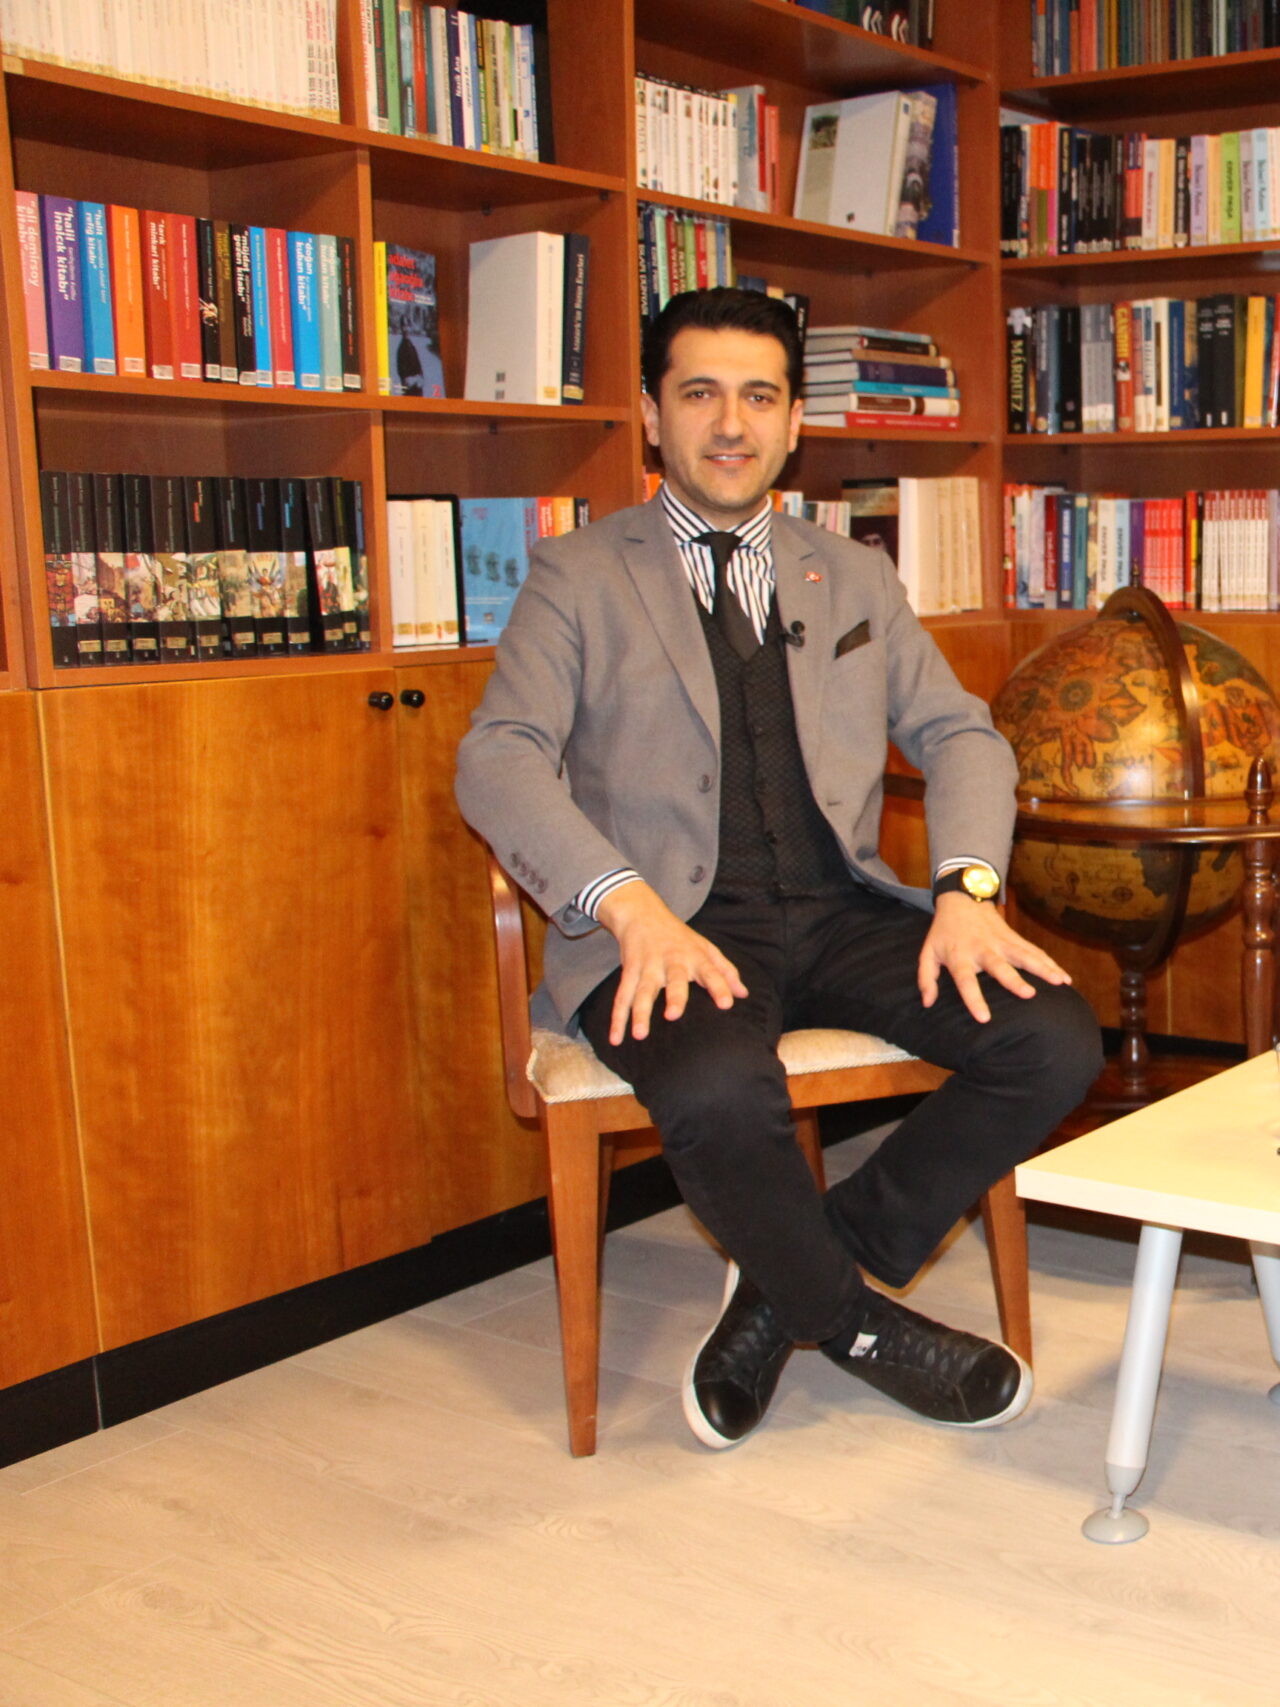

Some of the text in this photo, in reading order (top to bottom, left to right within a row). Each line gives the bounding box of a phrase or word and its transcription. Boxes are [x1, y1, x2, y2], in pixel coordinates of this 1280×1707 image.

[28, 225, 39, 287] demirsoy
[1115, 307, 1131, 358] GANDHI
[1009, 340, 1026, 412] MÁRQUEZ
